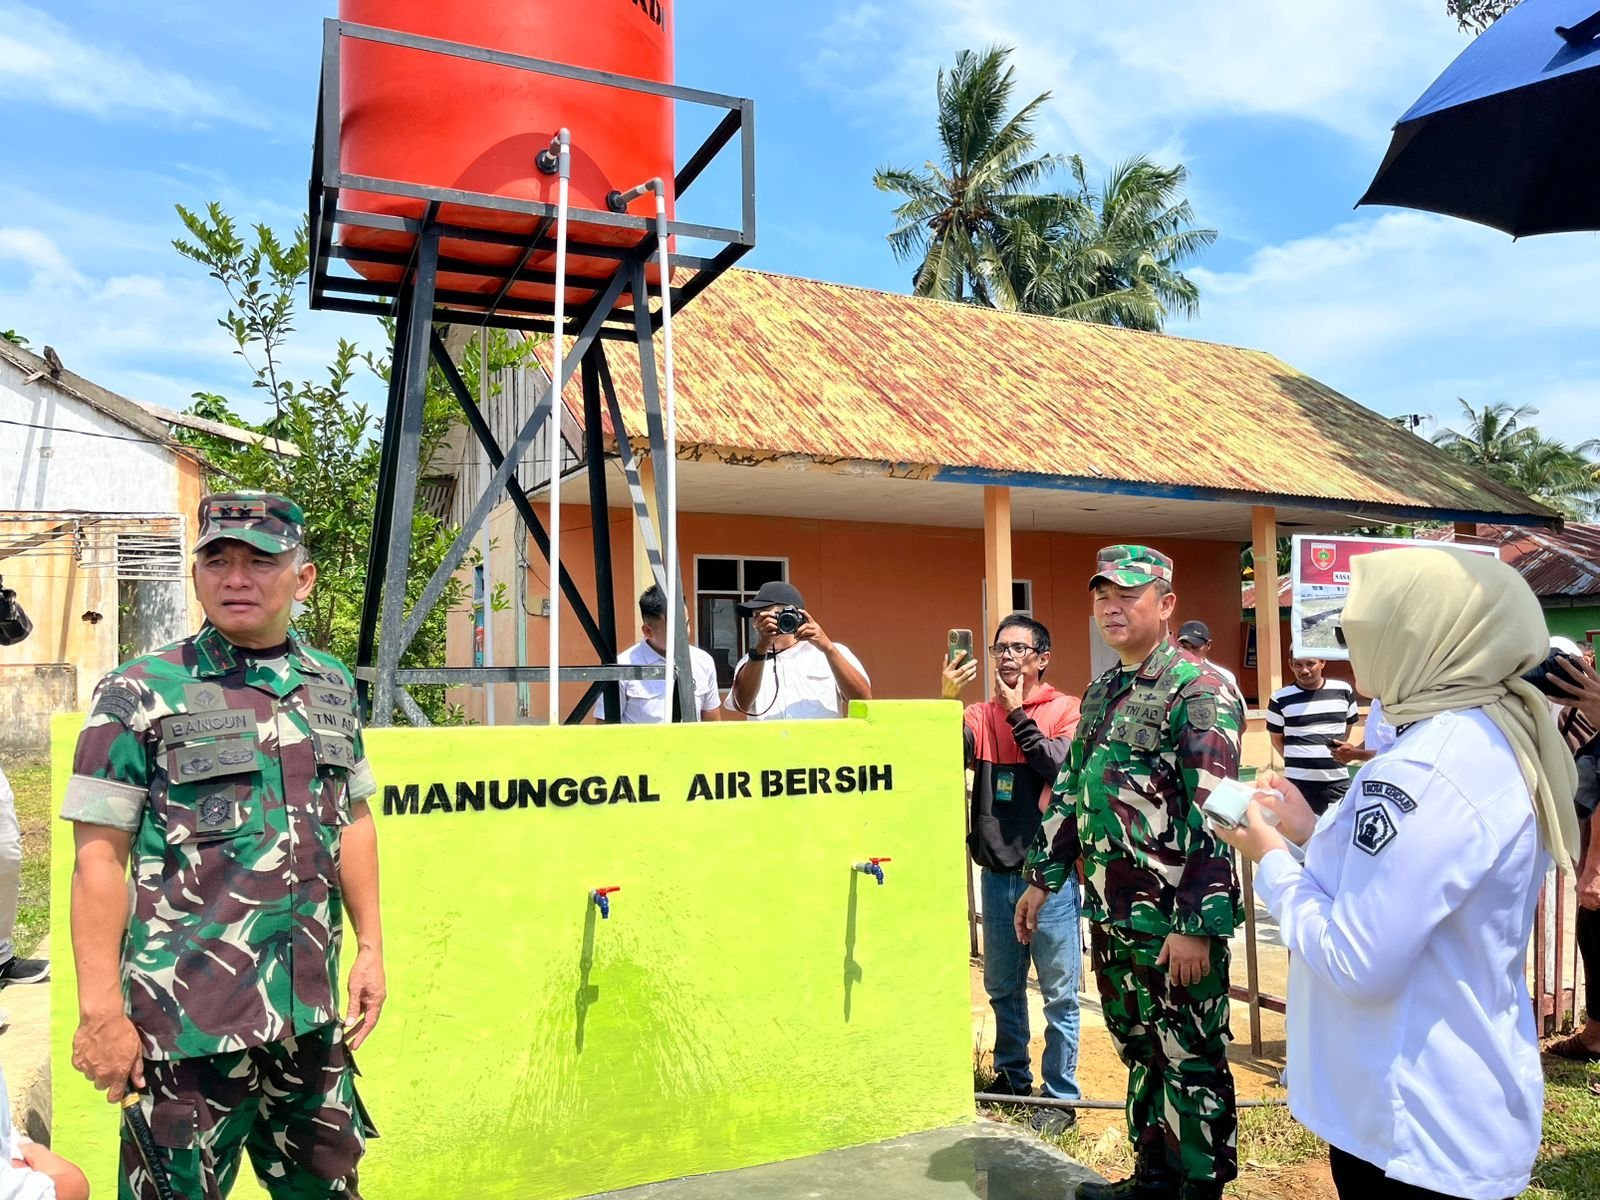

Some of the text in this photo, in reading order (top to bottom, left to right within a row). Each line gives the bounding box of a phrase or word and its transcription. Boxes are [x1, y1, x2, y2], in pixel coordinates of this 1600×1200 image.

[1125, 705, 1159, 720] TNI AD
[313, 713, 354, 732] TNI AD
[383, 764, 893, 816] MANUNGGAL AIR BERSIH
